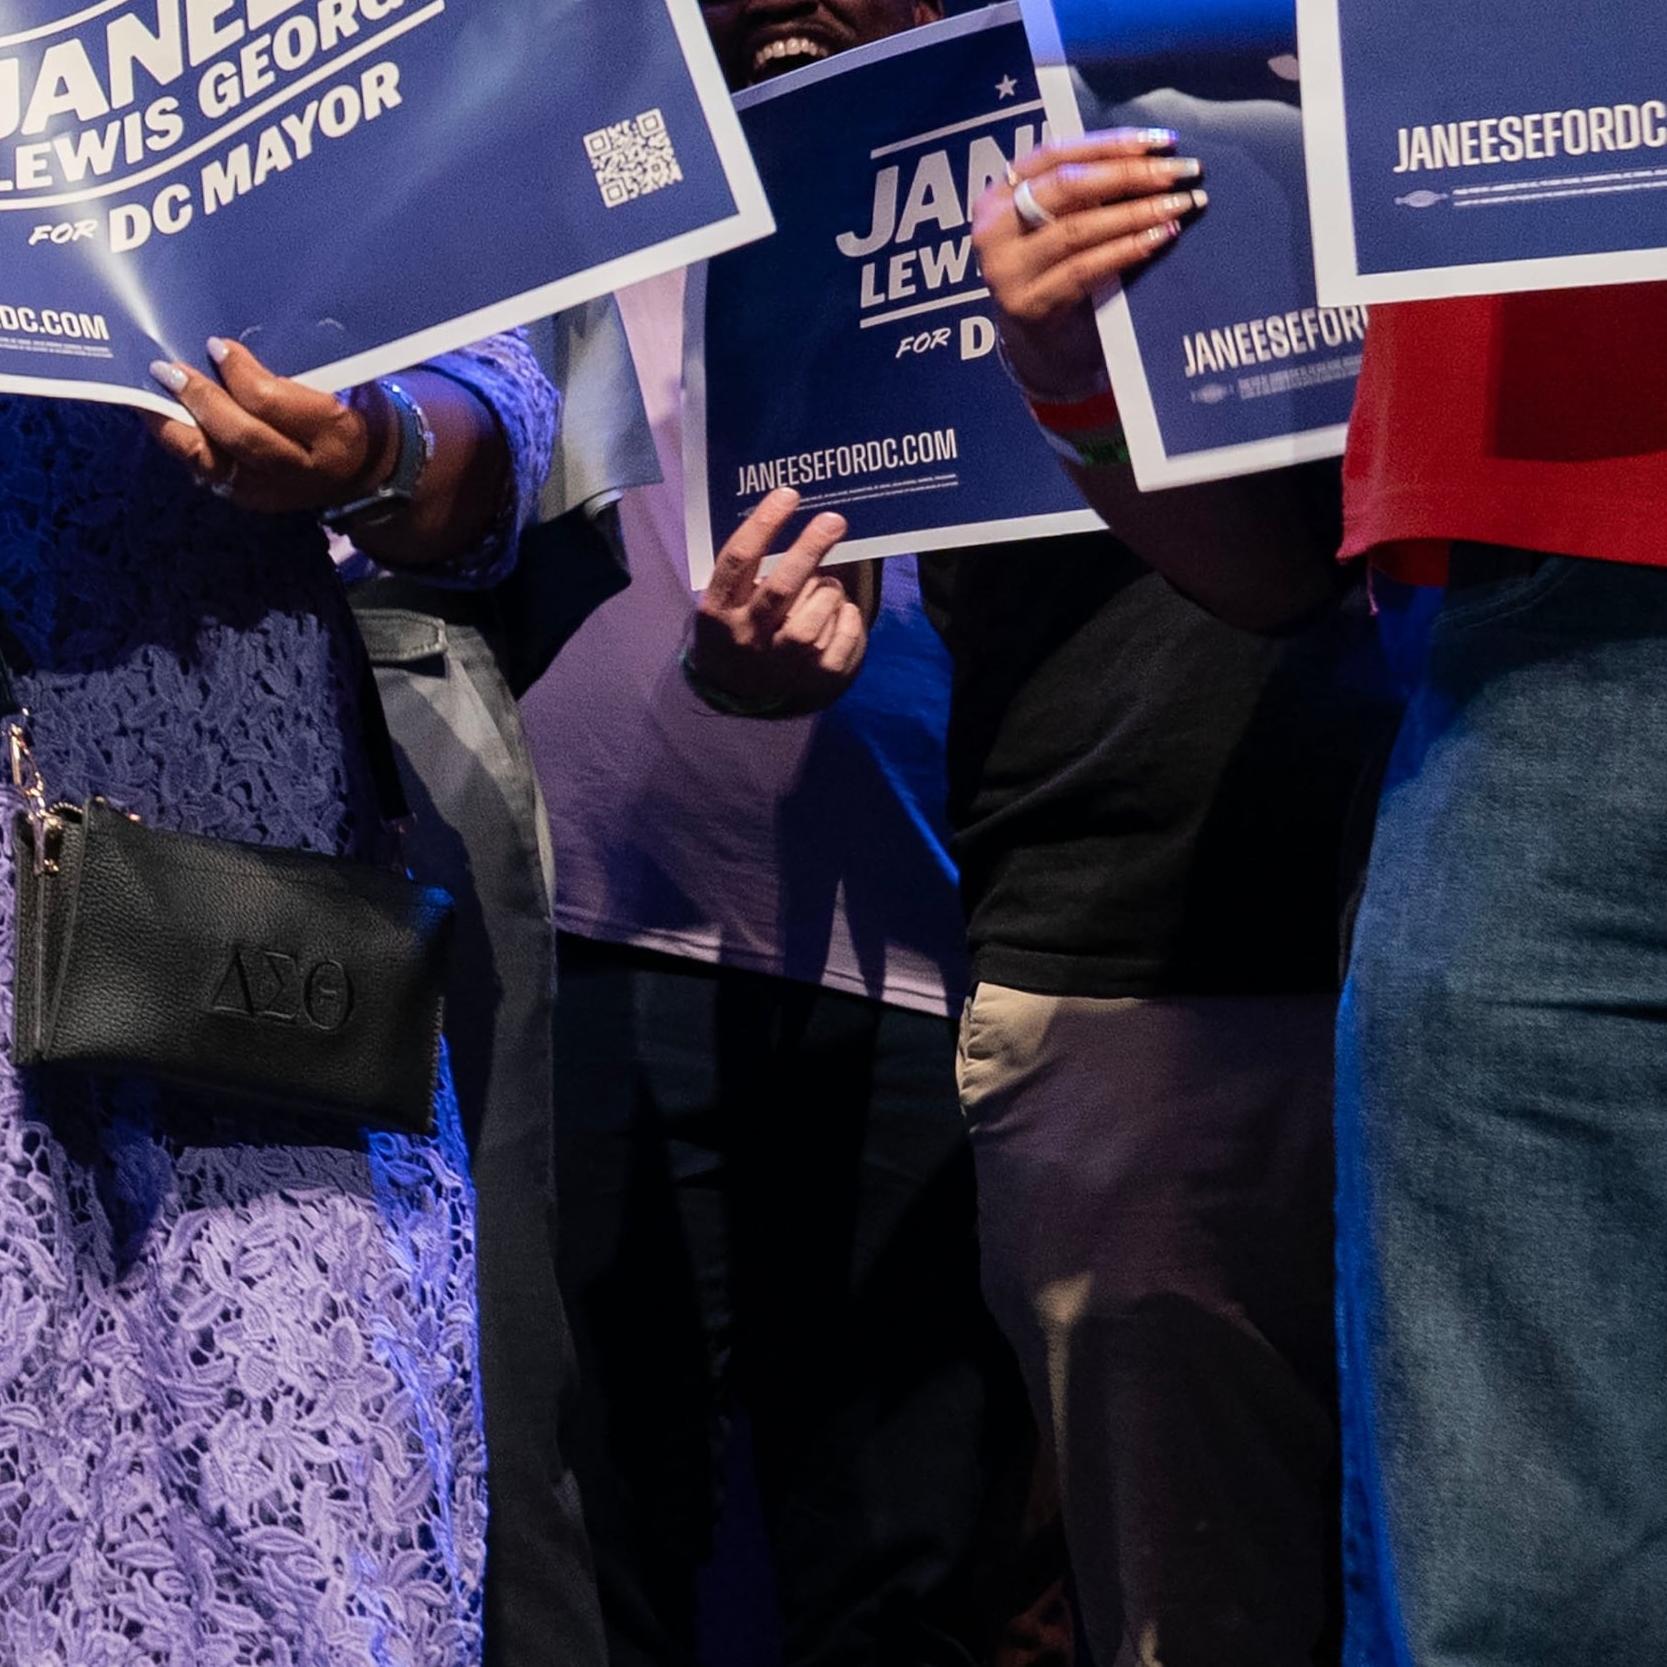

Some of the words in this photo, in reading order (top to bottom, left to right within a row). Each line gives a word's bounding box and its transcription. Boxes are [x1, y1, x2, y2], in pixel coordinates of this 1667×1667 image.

[28, 218, 97, 248] FOR
[109, 181, 193, 254] DC
[202, 61, 402, 217] MAYOR
[896, 326, 951, 359] FOR
[736, 428, 958, 497] JANEESEFORDC.COM
